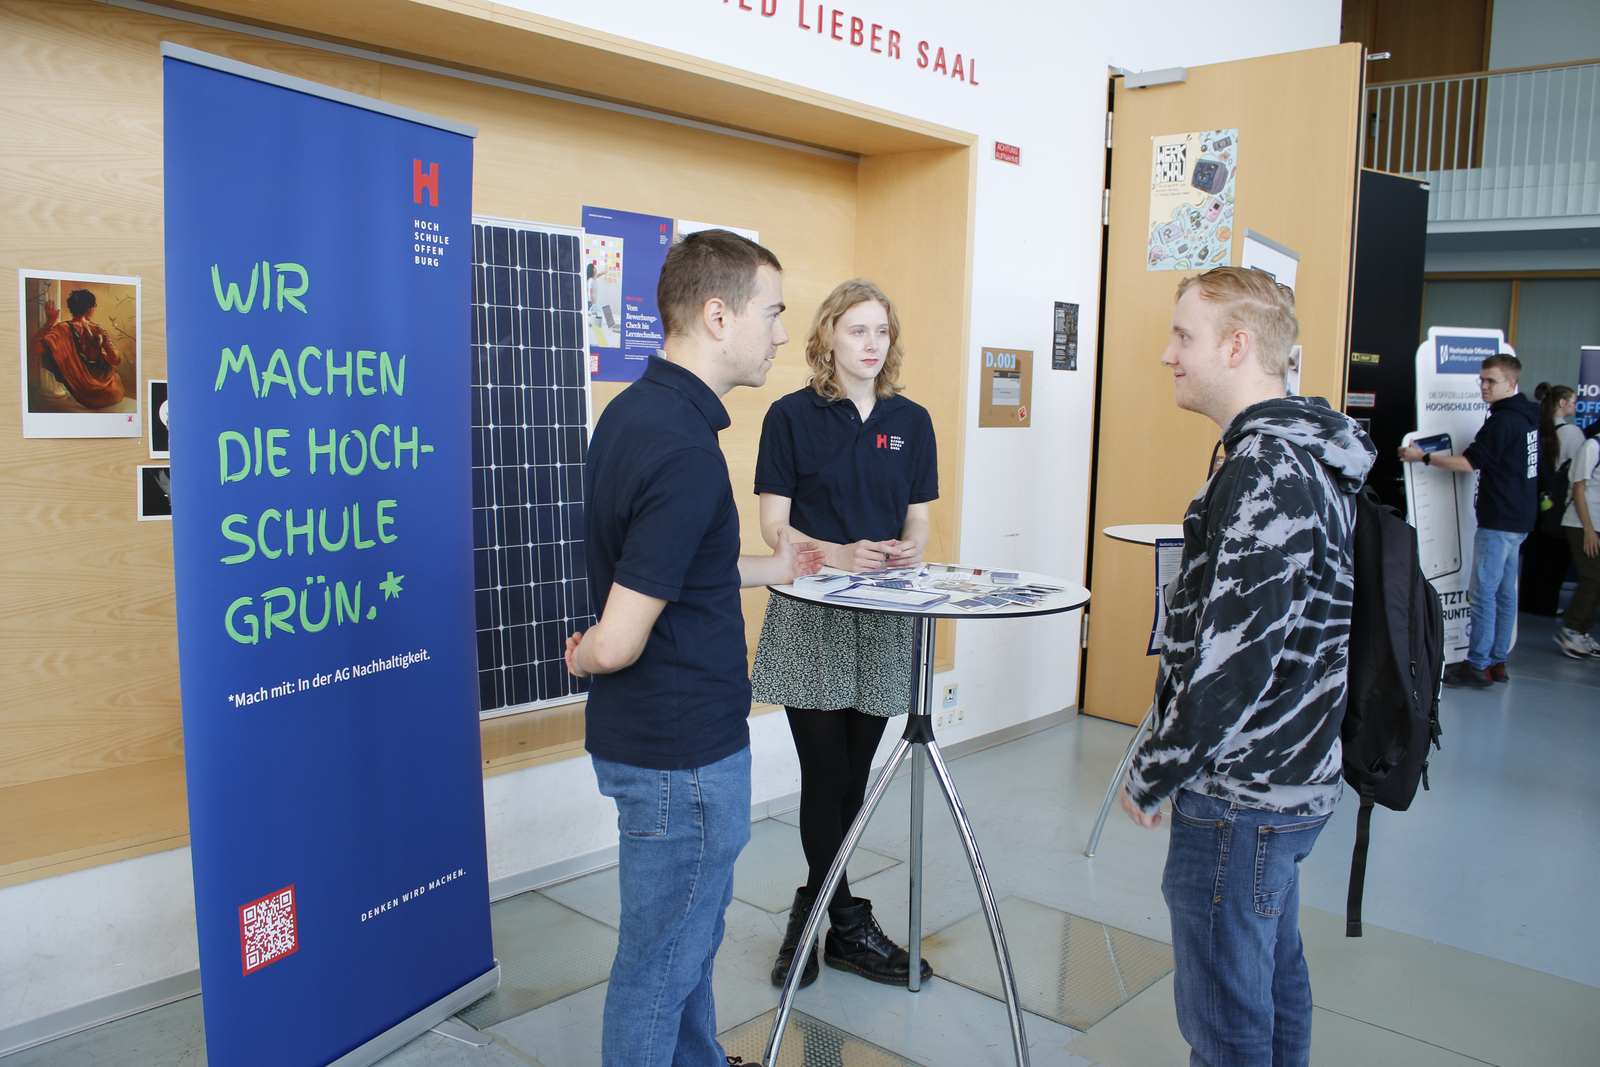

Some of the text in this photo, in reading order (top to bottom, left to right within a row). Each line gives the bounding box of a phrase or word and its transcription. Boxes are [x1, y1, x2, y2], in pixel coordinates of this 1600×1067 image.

[798, 0, 979, 86] LIEBER SAAL
[996, 144, 1018, 155] ACHTUNG
[996, 152, 1019, 164] AUFNAHME
[1156, 144, 1187, 164] WERK
[1156, 162, 1186, 185] SCHAU
[413, 159, 439, 207] H
[414, 219, 439, 232] HOCH
[414, 232, 449, 245] SCHULE
[414, 243, 444, 256] OFFEN
[414, 255, 439, 267] BURG
[211, 261, 309, 314] WIR
[986, 352, 1016, 368] D.001
[214, 344, 406, 399] MACHEN
[1576, 384, 1600, 397] HO
[1426, 402, 1472, 411] HOCHSCHULE
[876, 434, 888, 448] H
[218, 424, 434, 486] DIE HOCH-
[220, 499, 398, 565] SCHULE
[271, 681, 295, 699] mit:
[298, 678, 310, 692] In
[312, 673, 332, 688] der
[334, 668, 350, 682] AG
[352, 649, 431, 678] Nachhaltigkeit.
[361, 868, 466, 922] DENKEN WIRD MACHEN.
